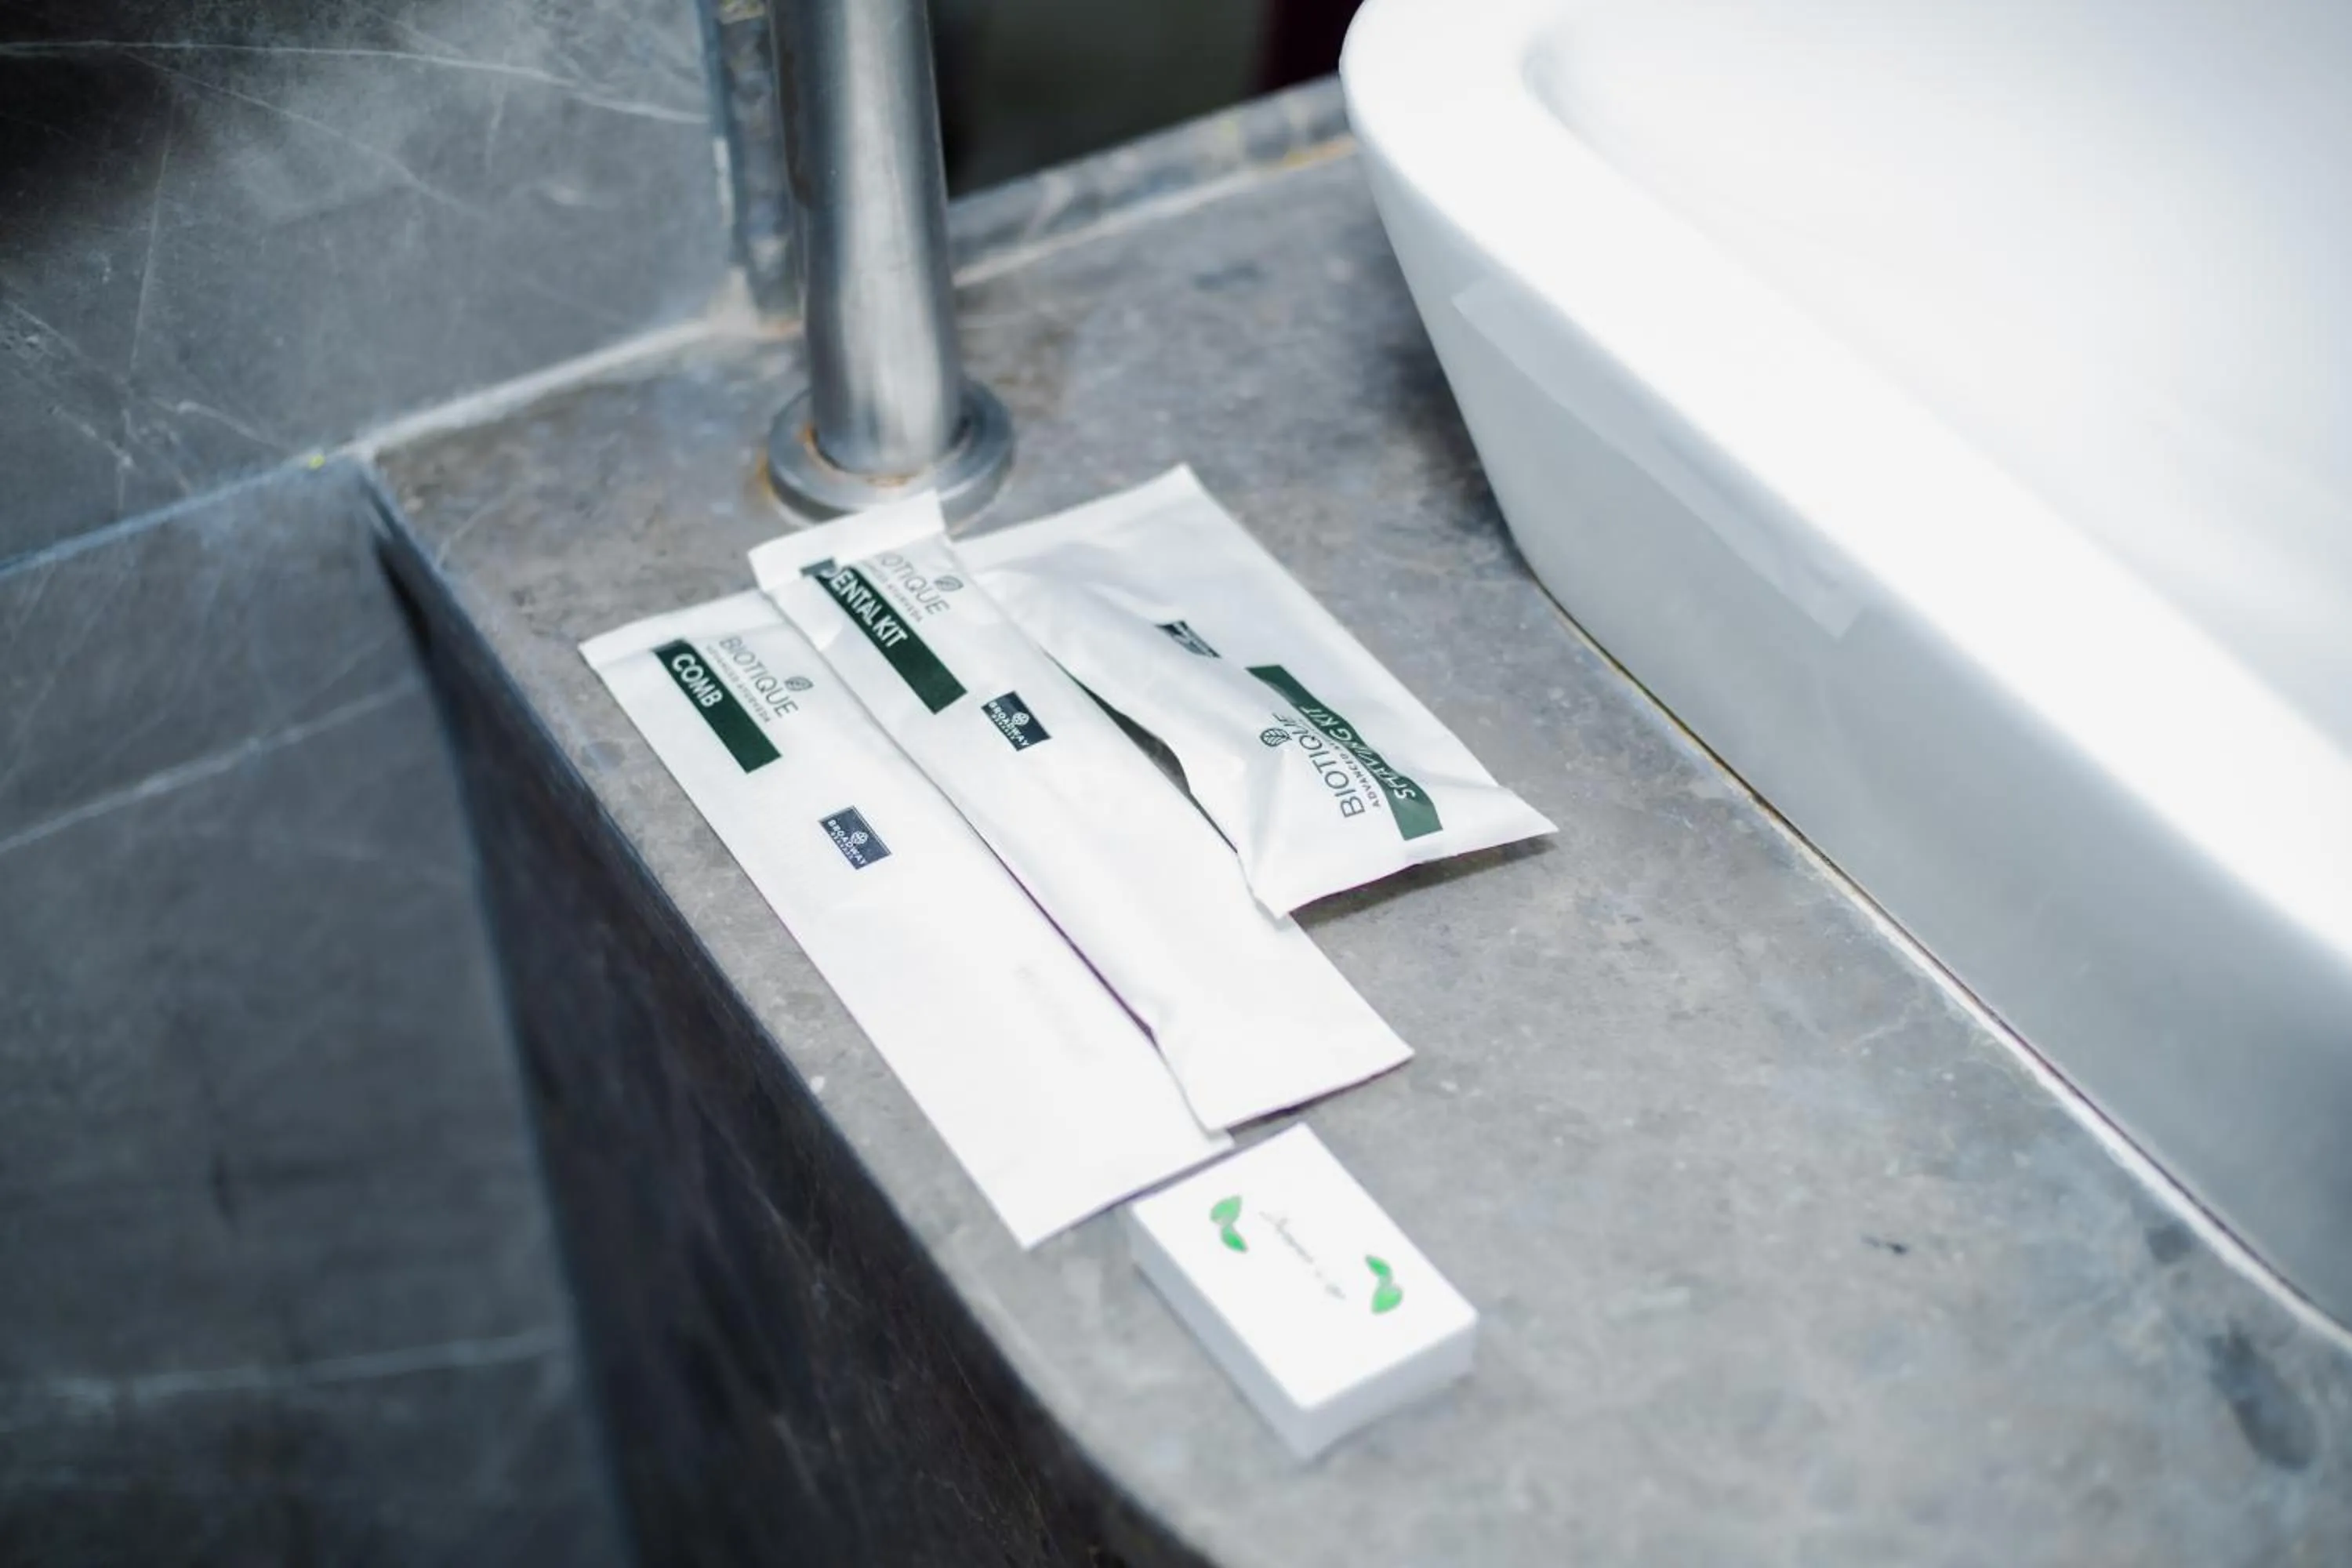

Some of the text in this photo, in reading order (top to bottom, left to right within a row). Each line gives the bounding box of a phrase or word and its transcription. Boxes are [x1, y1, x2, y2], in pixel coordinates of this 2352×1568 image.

[875, 552, 951, 615] OTIQUE
[872, 615, 909, 648] KIT
[672, 653, 724, 708] COMB
[989, 701, 1029, 746] BROADWAY
[1299, 706, 1339, 727] KIT
[828, 818, 867, 865] BROADWAY
